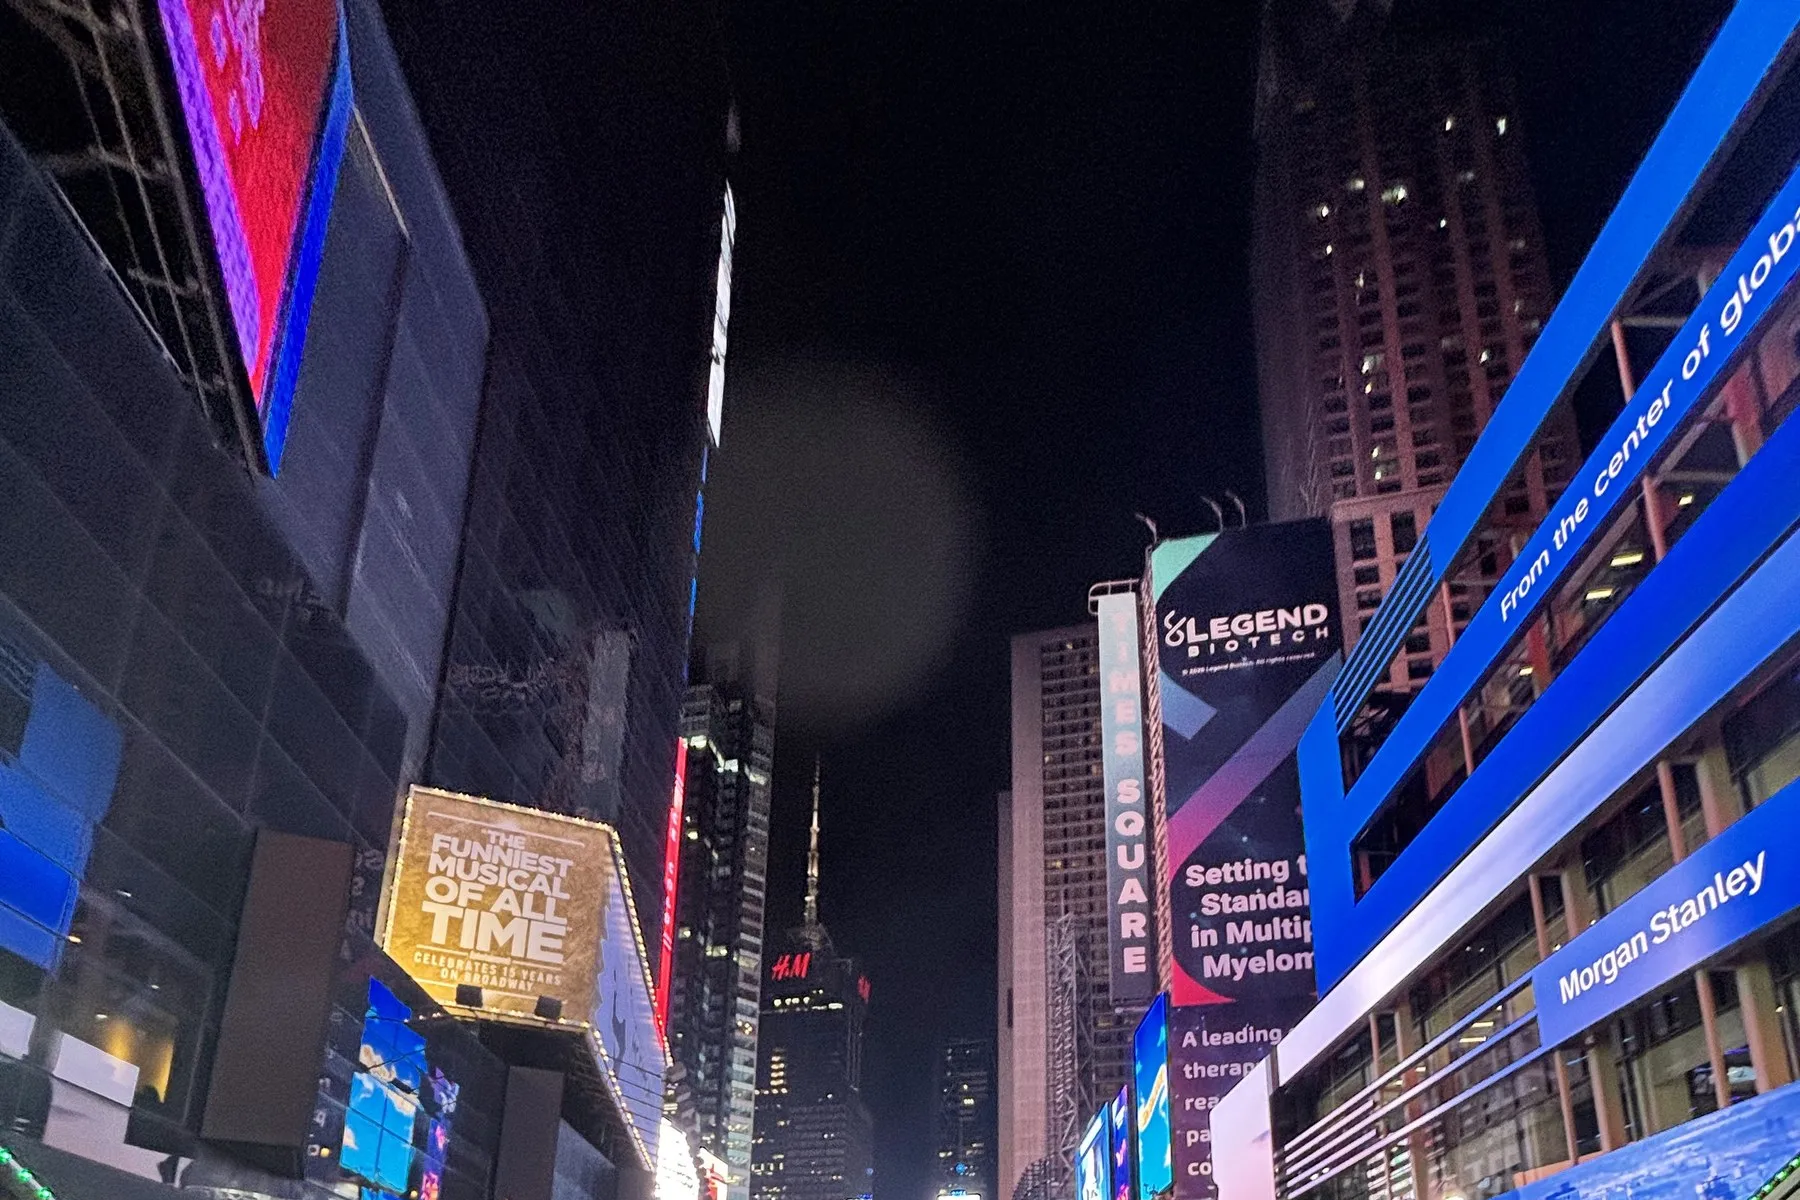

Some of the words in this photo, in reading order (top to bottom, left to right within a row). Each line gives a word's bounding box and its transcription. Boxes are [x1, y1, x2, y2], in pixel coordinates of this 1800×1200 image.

[1502, 550, 1551, 623] From
[1552, 497, 1589, 555] the
[1593, 378, 1674, 498] center
[1681, 322, 1710, 381] of
[1186, 603, 1328, 643] LEGEND
[1187, 626, 1329, 658] BIOTECH
[1109, 611, 1140, 757] TIMES
[428, 853, 570, 900] MUSICAL
[433, 832, 574, 878] FUNNIEST
[1114, 778, 1148, 974] SQUARE
[1185, 858, 1290, 887] Setting
[425, 875, 486, 908] OF
[489, 888, 568, 925] ALL
[421, 900, 567, 965] TIME
[1190, 924, 1218, 948] in
[1558, 930, 1648, 1005] Morgan
[1649, 850, 1766, 945] Stanley
[414, 951, 497, 976] CELEBRATES
[521, 969, 562, 986] YEARS
[440, 967, 458, 980] ON
[464, 973, 534, 992] BROADWAY
[1181, 1031, 1197, 1048] A
[1201, 1025, 1282, 1046] leading
[1184, 1095, 1225, 1111] rea
